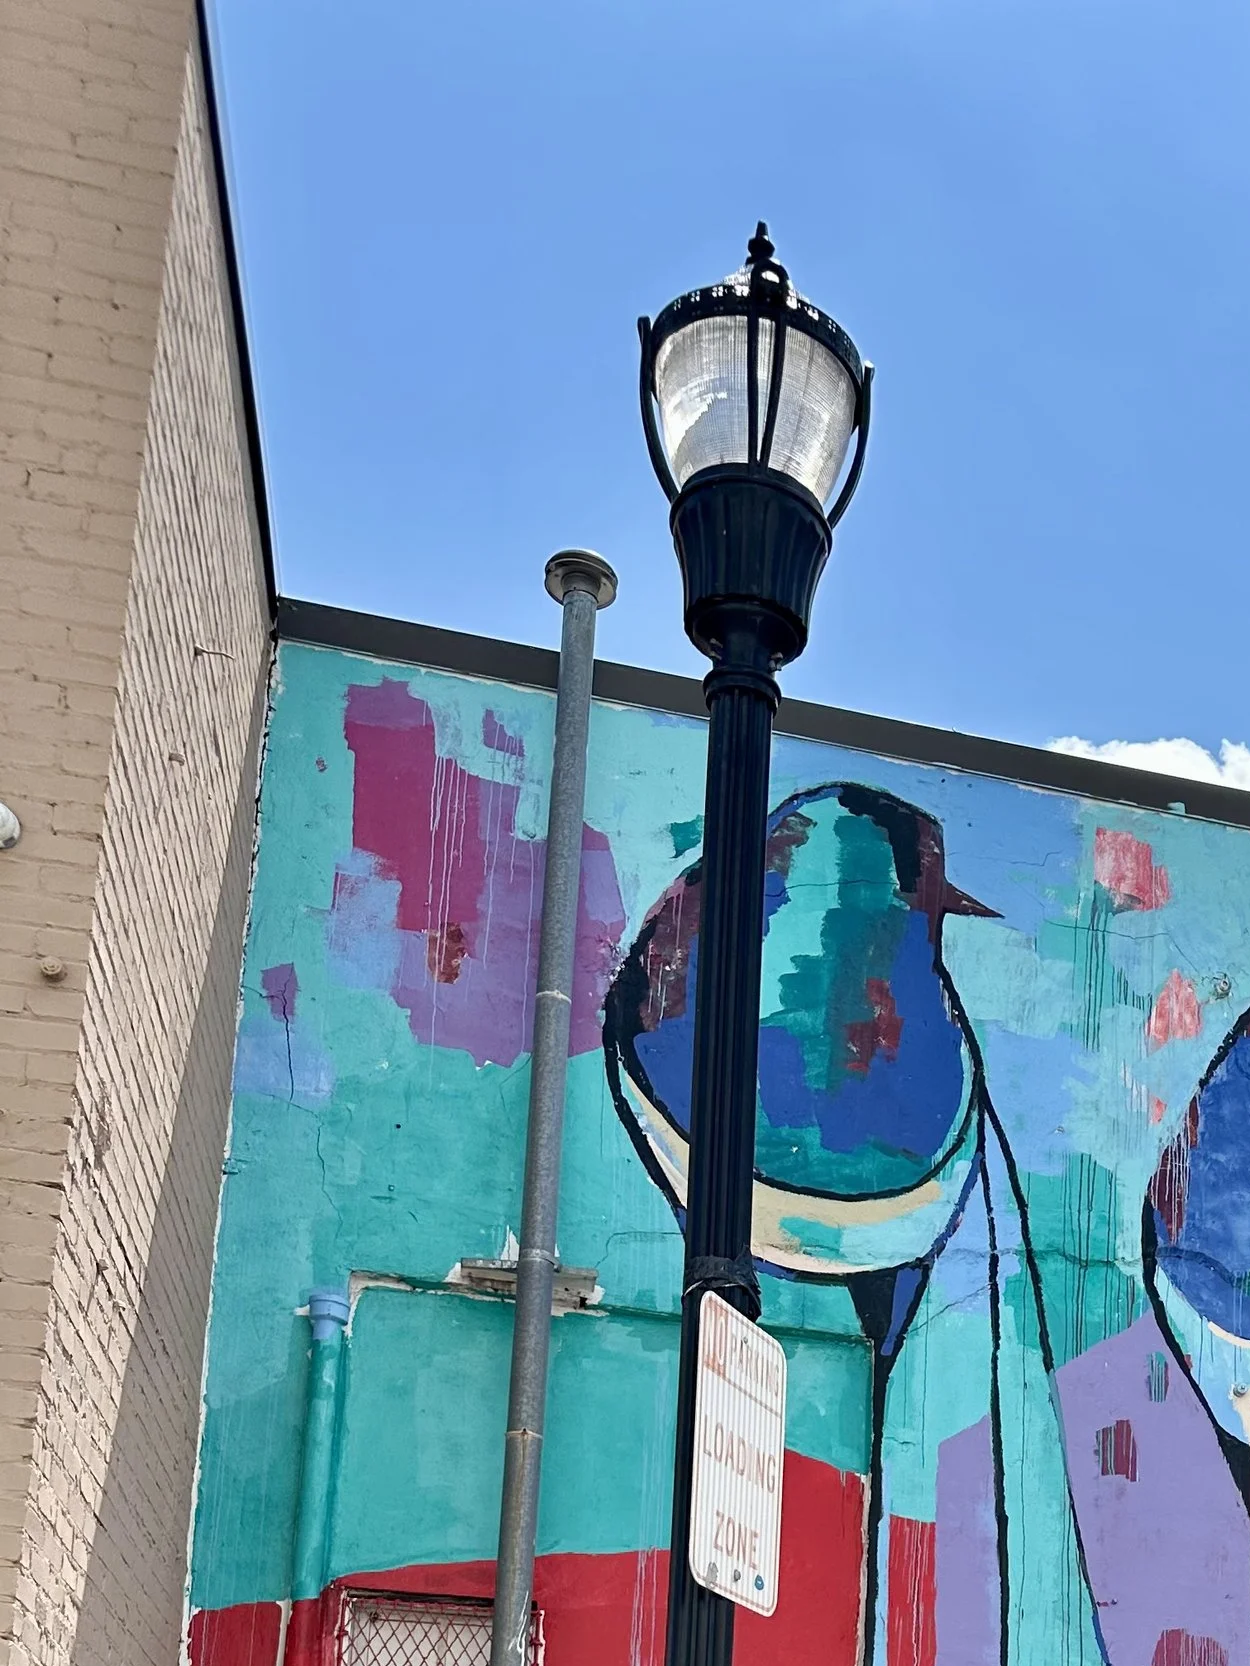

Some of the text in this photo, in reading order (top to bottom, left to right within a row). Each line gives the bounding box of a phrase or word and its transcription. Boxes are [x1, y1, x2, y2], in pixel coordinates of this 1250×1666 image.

[704, 1300, 780, 1397] NO PARKING
[703, 1413, 776, 1494] LOADING
[713, 1509, 759, 1571] ZONE
